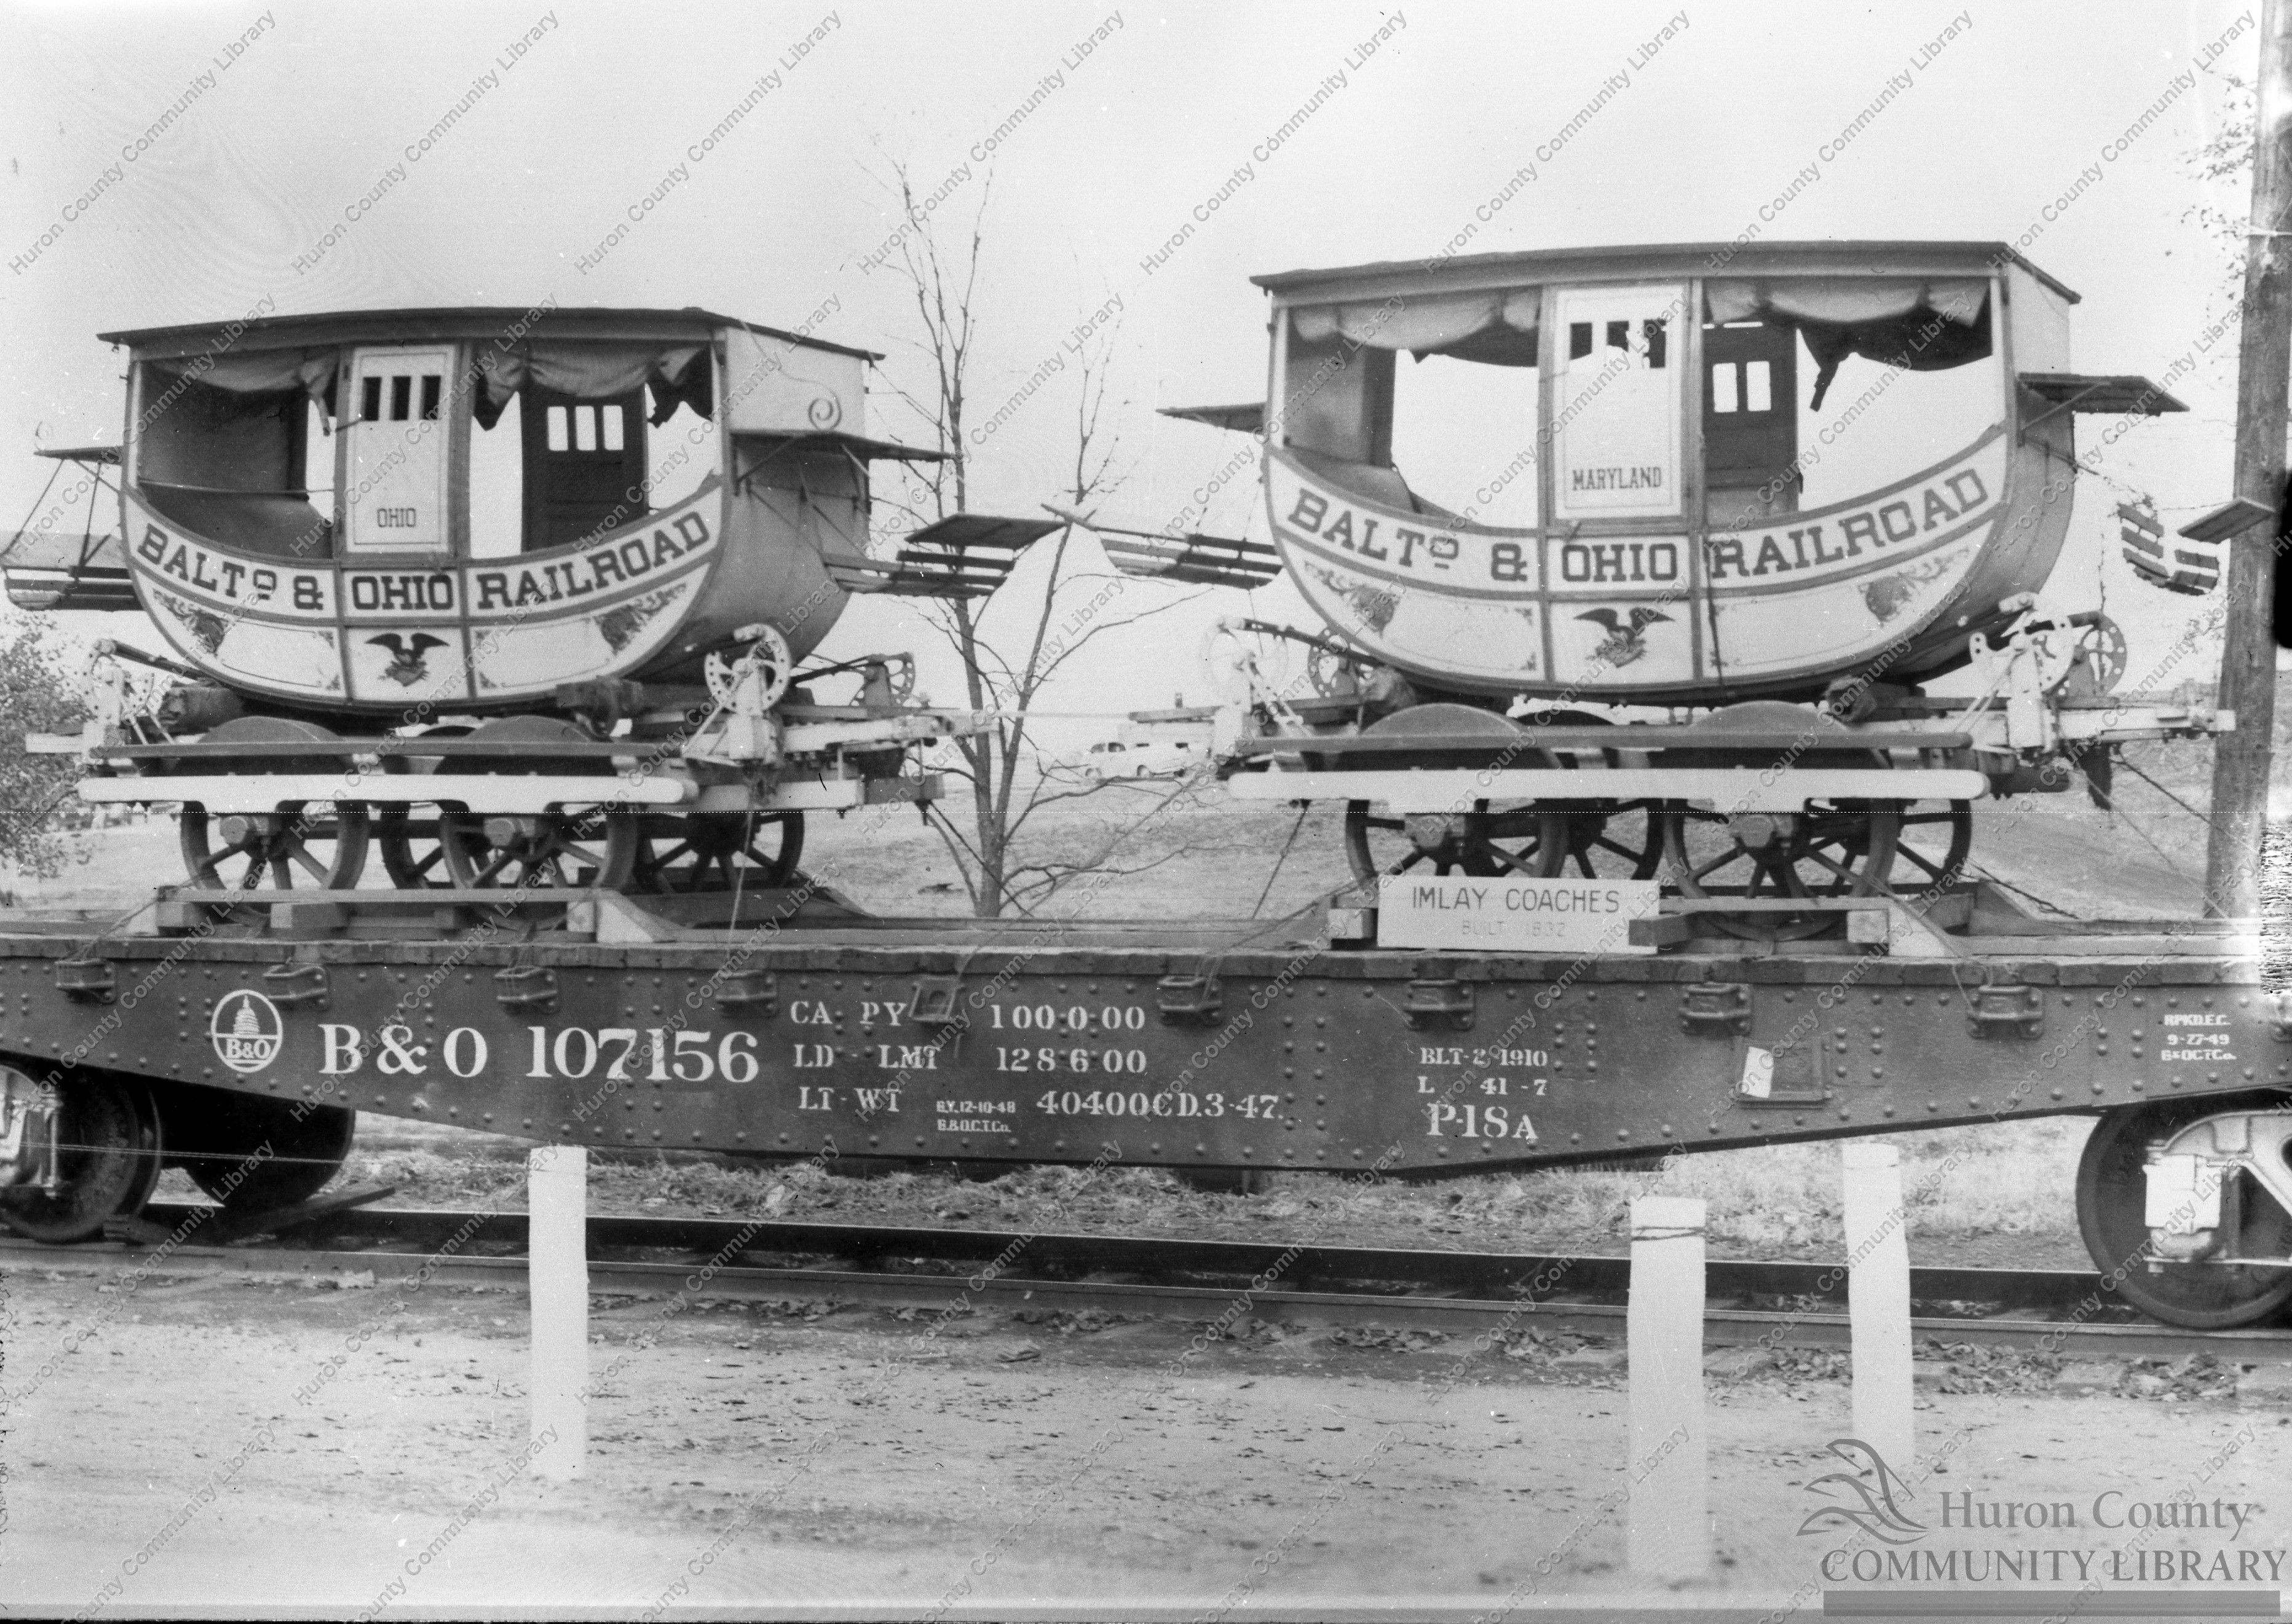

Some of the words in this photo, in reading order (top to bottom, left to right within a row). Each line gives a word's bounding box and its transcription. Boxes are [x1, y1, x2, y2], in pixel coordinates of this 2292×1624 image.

[1573, 467, 1661, 491] MARYLAND
[377, 508, 416, 527] OHIO
[1491, 543, 1528, 581] &
[1562, 543, 1677, 582] OHIO
[1704, 468, 1989, 579] RAILROAD
[293, 575, 323, 610] &
[352, 575, 454, 610] OHIO
[476, 511, 709, 610] RAILROAD
[1413, 886, 1488, 910] IMLAY
[1506, 888, 1620, 913] COACHES
[860, 1002, 907, 1026] PY
[226, 1039, 271, 1059] B&O
[526, 1025, 759, 1084] 107156
[793, 1044, 834, 1067] LD
[877, 1044, 941, 1070] LMT
[1417, 1076, 1436, 1094] L
